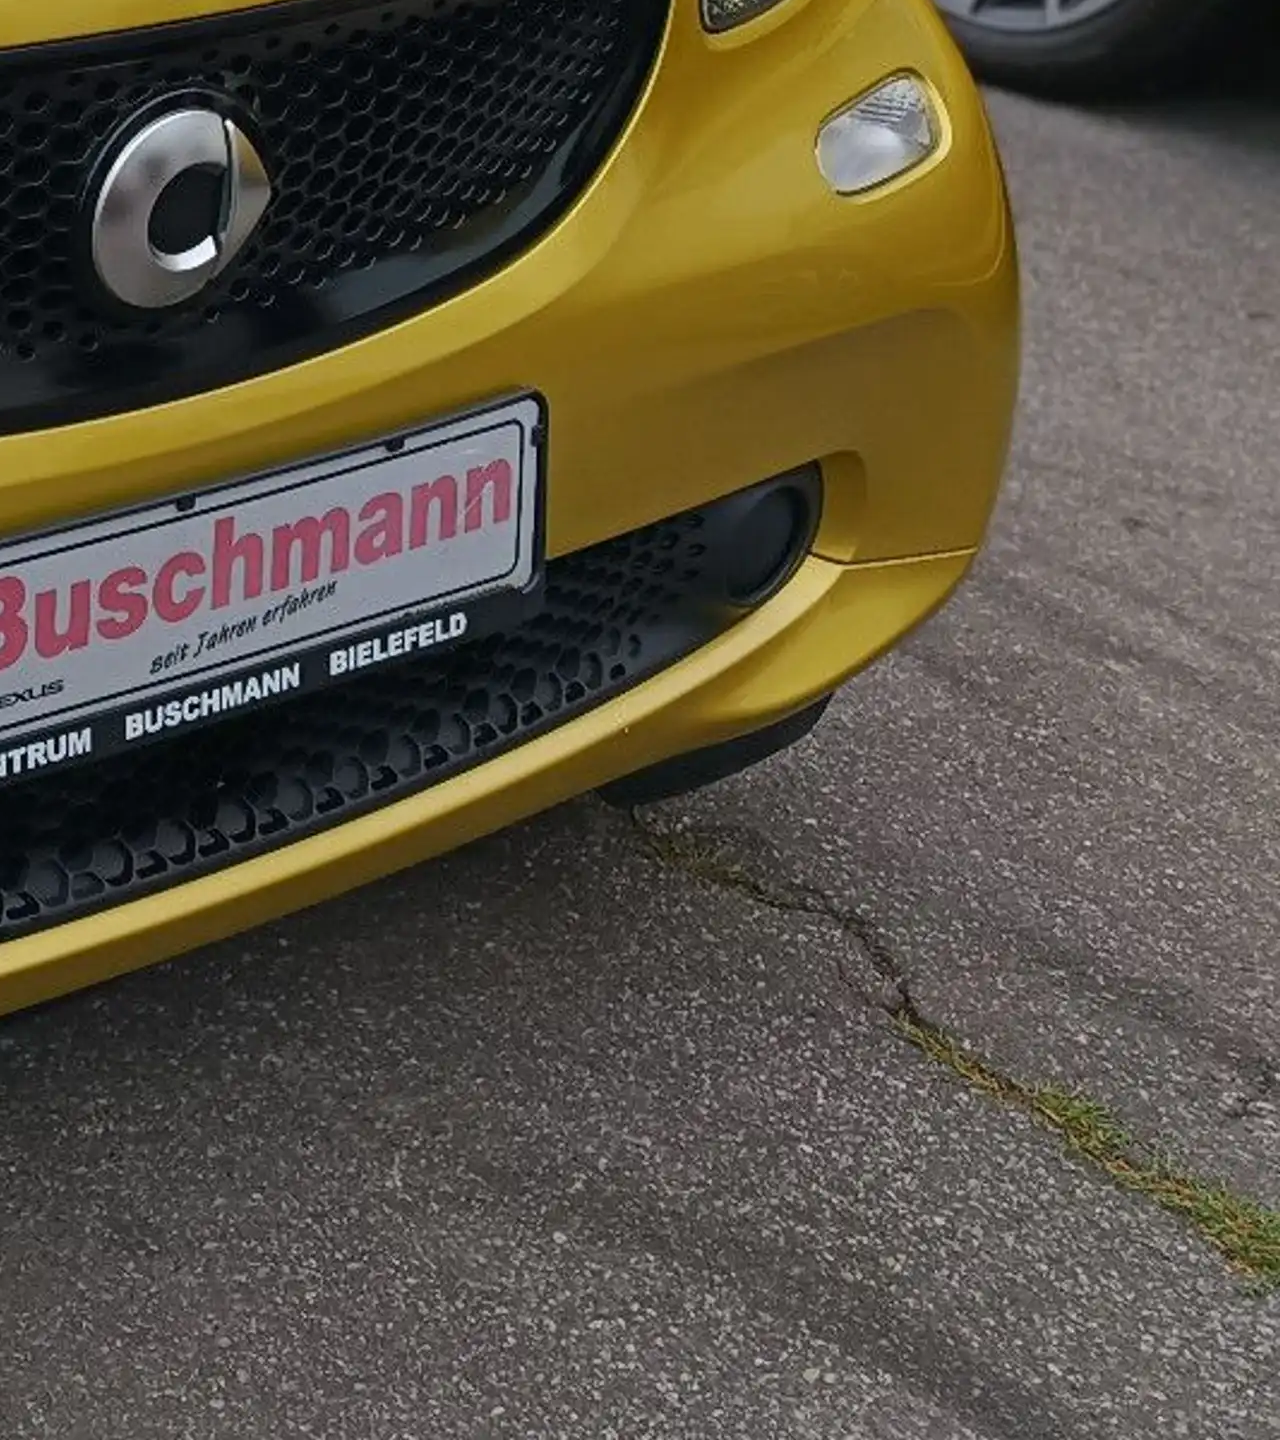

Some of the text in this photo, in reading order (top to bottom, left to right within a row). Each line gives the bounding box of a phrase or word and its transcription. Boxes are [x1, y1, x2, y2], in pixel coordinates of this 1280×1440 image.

[193, 616, 258, 658] Jahren
[262, 580, 339, 625] erfahren
[125, 662, 300, 741] BUSCHMANN
[329, 611, 468, 677] BIELEFELD
